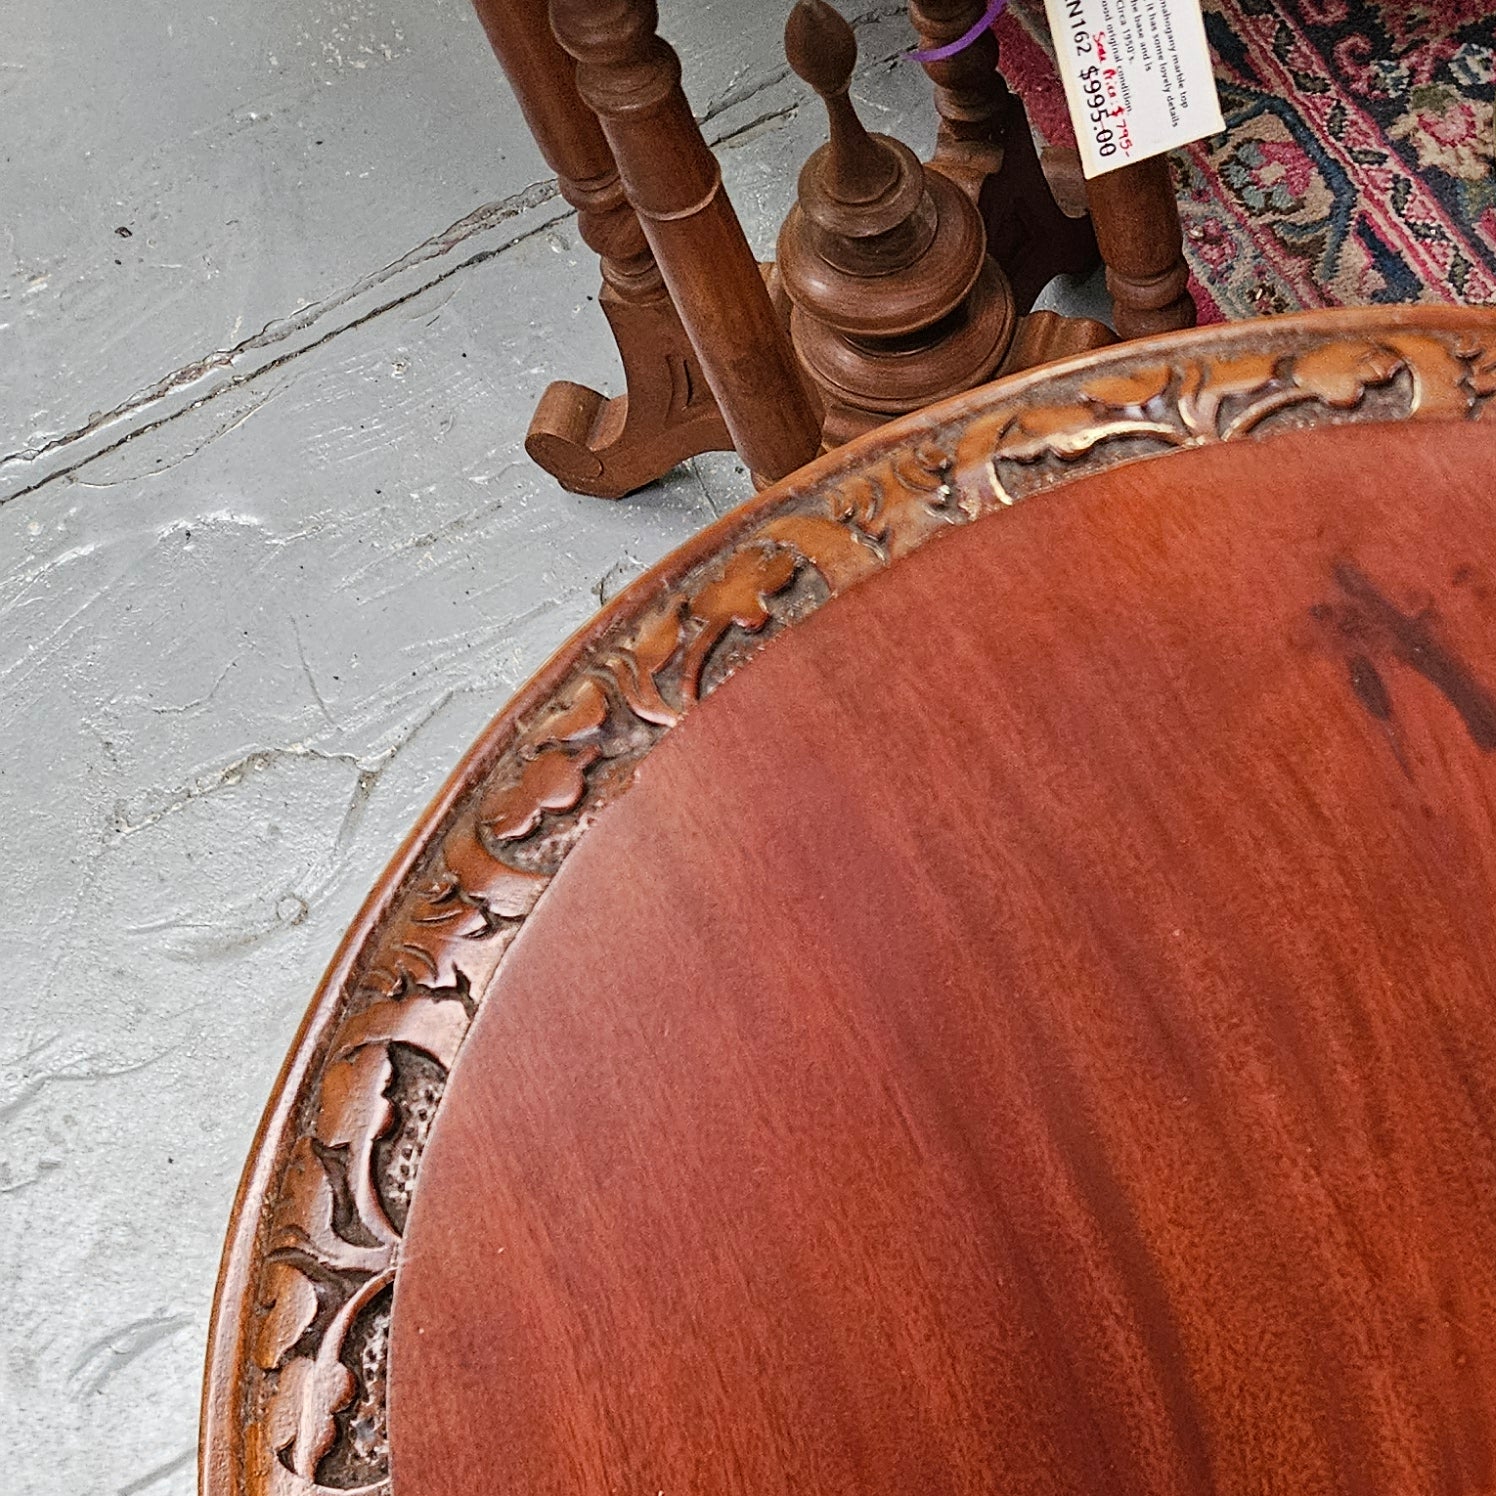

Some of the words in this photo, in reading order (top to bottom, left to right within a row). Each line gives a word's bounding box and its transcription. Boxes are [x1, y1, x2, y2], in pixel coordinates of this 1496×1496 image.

[1102, 0, 1113, 22] ood
[1116, 0, 1127, 26] Circa
[1130, 0, 1138, 12] he
[1065, 0, 1092, 56] N162
[1134, 14, 1144, 38] base
[1107, 24, 1123, 63] original
[1140, 42, 1151, 61] and
[1144, 62, 1152, 72] is
[1149, 13, 1157, 32] has
[1153, 34, 1164, 60] some
[1160, 62, 1172, 92] lovely
[1167, 95, 1180, 128] details
[1172, 54, 1185, 89] marble
[1180, 91, 1188, 108] top
[1078, 65, 1117, 157] $995.00
